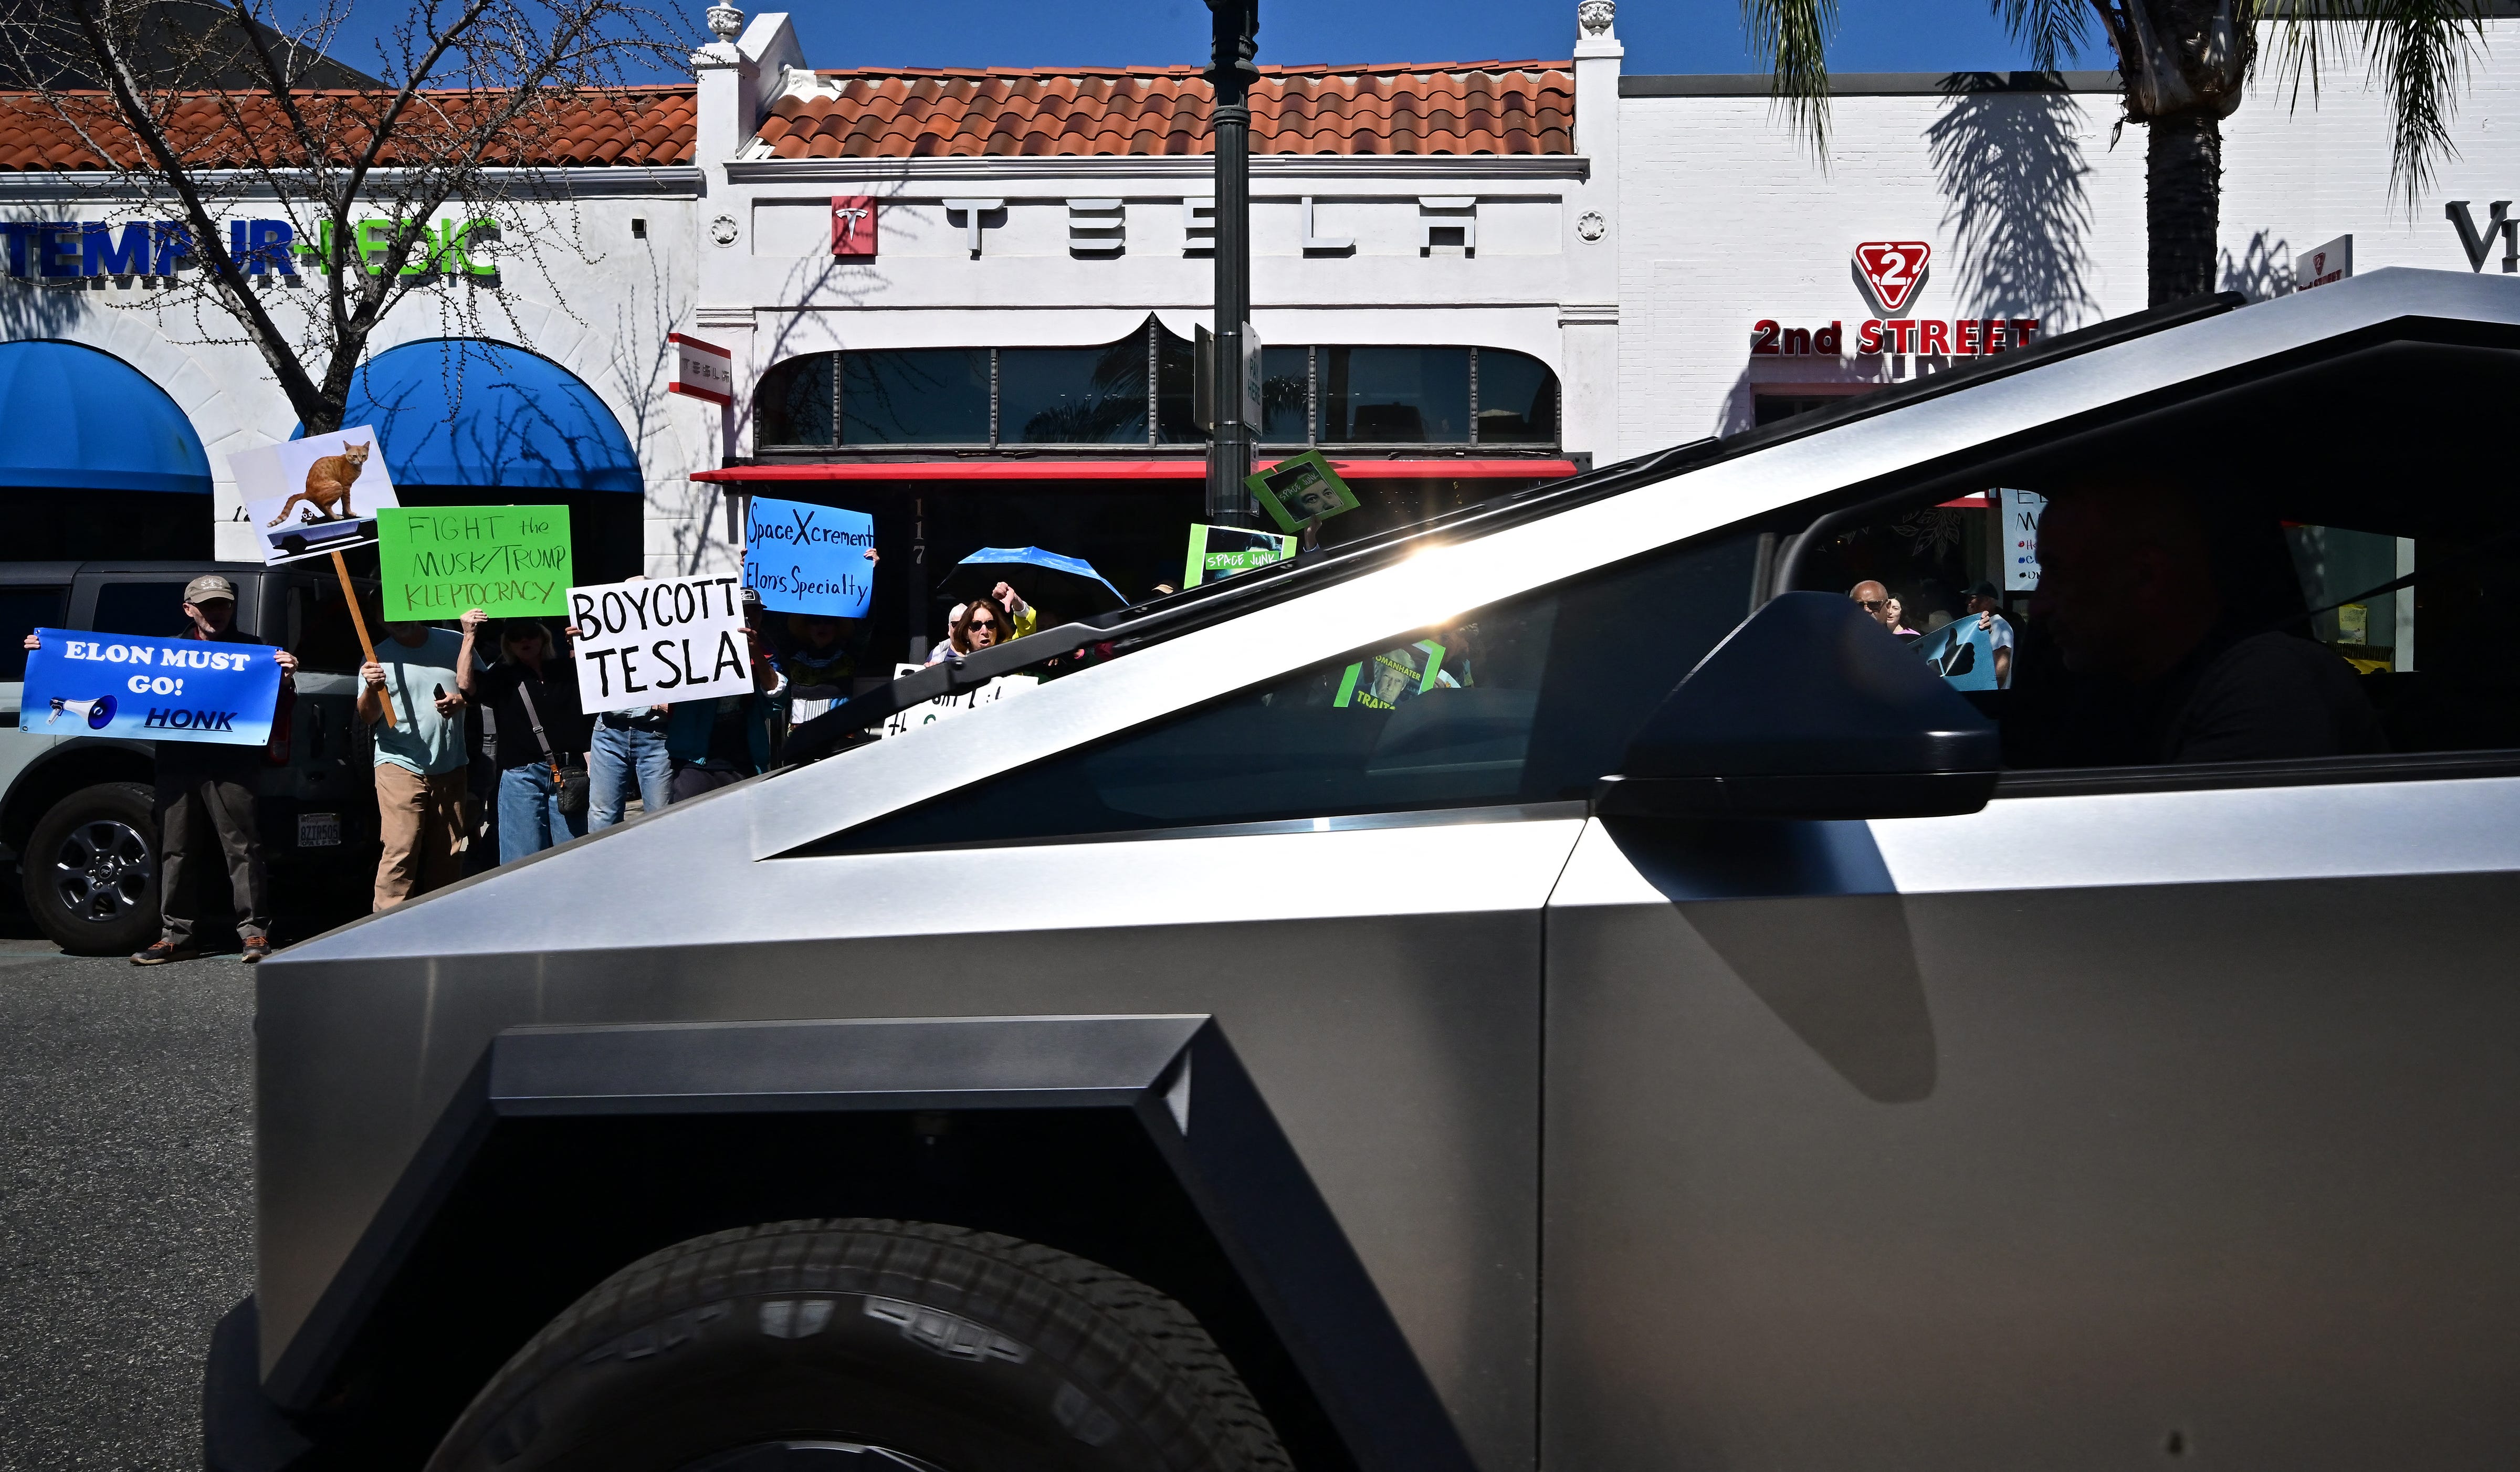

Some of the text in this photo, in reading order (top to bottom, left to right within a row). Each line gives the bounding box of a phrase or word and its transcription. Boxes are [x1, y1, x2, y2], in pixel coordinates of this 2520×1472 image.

[942, 197, 1476, 251] TESLA
[1750, 319, 2040, 356] 2nd STREET
[682, 358, 729, 383] TESLA
[1250, 358, 1258, 381] PAY
[1279, 482, 1300, 500] SPACE
[409, 516, 549, 543] FIGHT the
[1208, 554, 1244, 567] SPACE
[405, 581, 555, 611] KLEPTOCRACY
[791, 565, 868, 606] Specialty
[573, 578, 738, 641] BOYCOTT
[64, 641, 250, 672] ELON MUST
[585, 631, 746, 698] TESLA
[1376, 655, 1421, 680] OMANHATER
[128, 675, 183, 696] GO!
[1358, 690, 1395, 710] TRAIT
[144, 708, 237, 731] HONK
